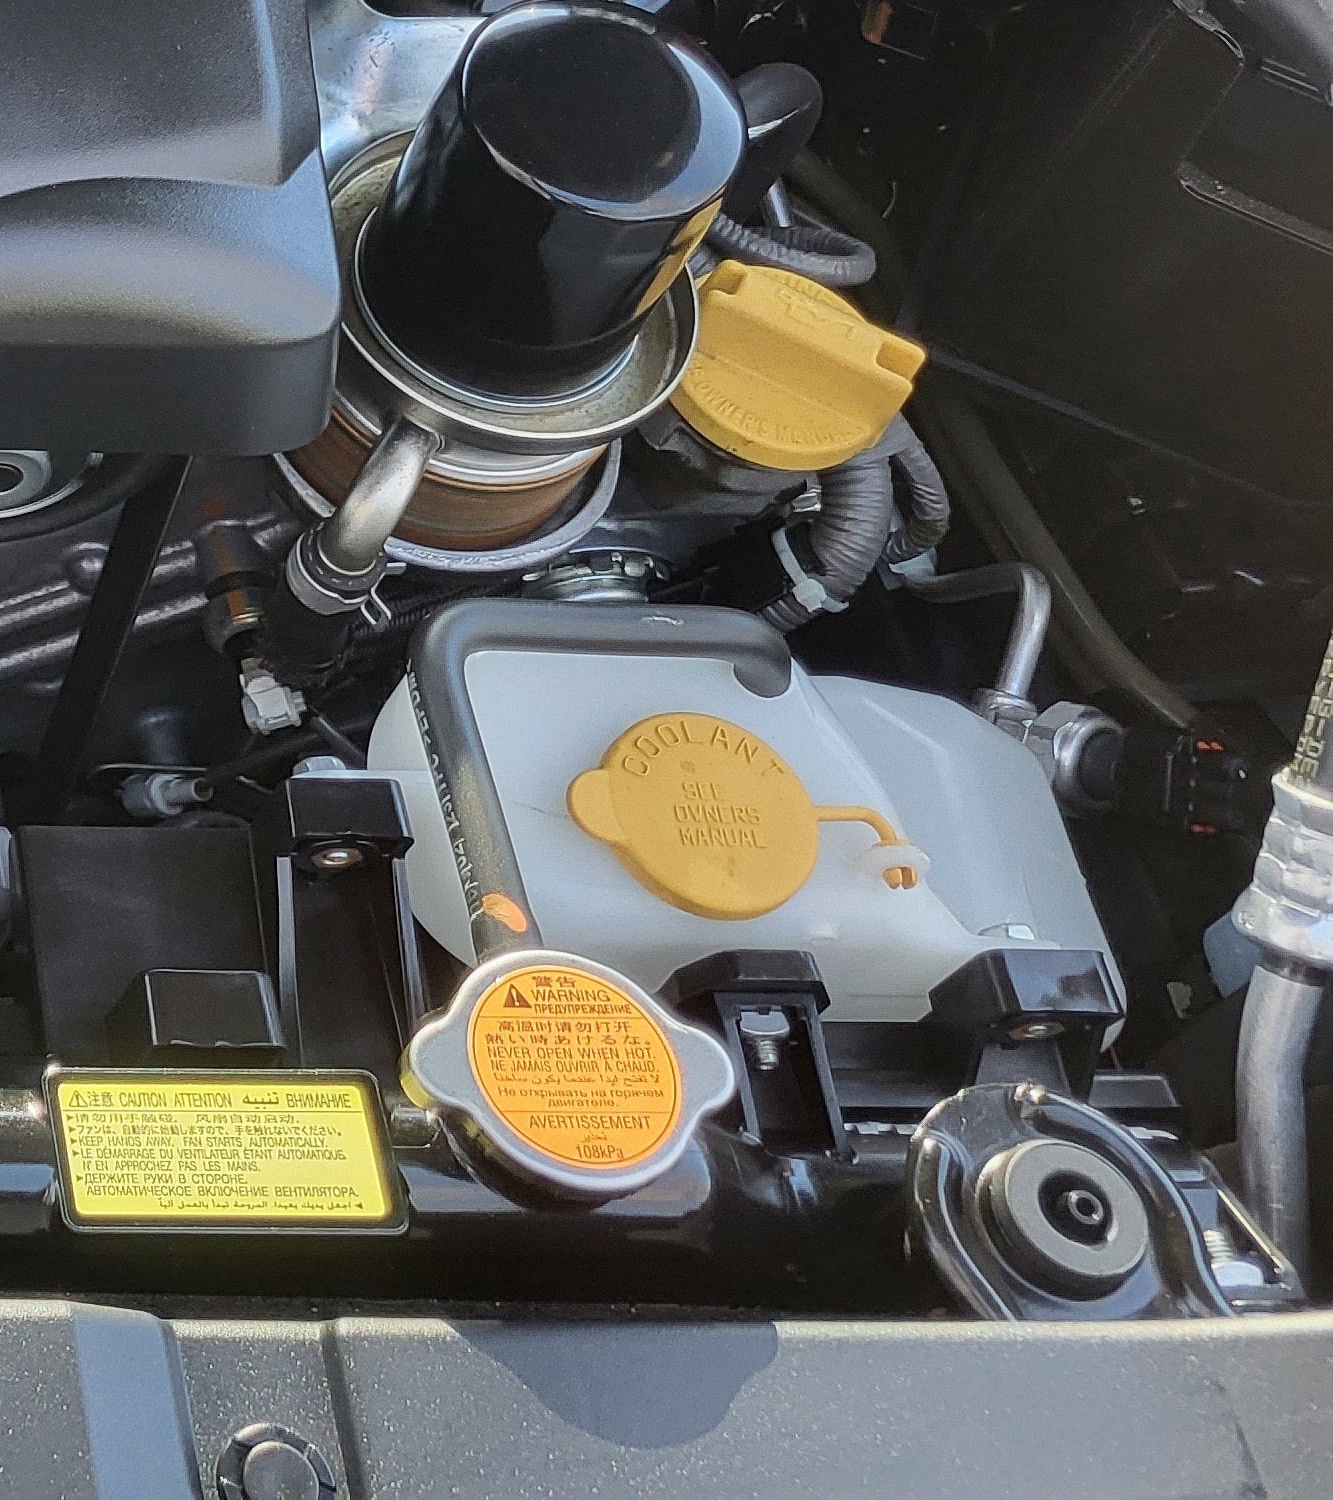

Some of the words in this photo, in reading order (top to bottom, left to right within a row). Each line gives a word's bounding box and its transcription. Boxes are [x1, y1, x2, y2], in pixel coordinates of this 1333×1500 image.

[621, 719, 785, 779] COOLANT
[679, 828, 768, 849] MANUAL
[531, 975, 577, 988] 警告
[531, 989, 611, 1003] WARNING
[534, 1003, 632, 1015] ПРЕДУПРЕЖДЕНИЕ
[487, 1046, 532, 1059] NEVER
[536, 1047, 573, 1059] OPEN
[577, 1047, 620, 1059] WHEN
[626, 1047, 656, 1059] HOT.
[490, 1059, 506, 1071] NE
[510, 1060, 552, 1072] JAMAIS
[555, 1060, 601, 1072] OUVRIR
[615, 1060, 660, 1073] CHAUD.
[87, 1090, 114, 1107] 注意
[119, 1092, 167, 1108] CAUTION
[174, 1092, 232, 1108] ATTENTION
[242, 1091, 280, 1110] تنبيه
[285, 1093, 352, 1109] ВНИМАНИЕ
[529, 1115, 652, 1130] AVERTISSEMENT
[79, 1136, 103, 1147] KEEP
[107, 1136, 142, 1147] HANDS
[146, 1136, 175, 1148] AWAY.
[183, 1136, 202, 1147] FAN
[206, 1136, 243, 1148] STARTS
[249, 1137, 328, 1148] AUTOMATICALLY.
[81, 1148, 93, 1159] LE
[96, 1146, 156, 1159] DÉMARRAGE
[159, 1148, 173, 1159] DU
[176, 1148, 239, 1160] VENTILATEUR
[243, 1147, 273, 1160] ÉTANT
[575, 1145, 625, 1160] 108kPa
[115, 1160, 173, 1171] APPROCHEZ
[178, 1160, 198, 1172] PAS
[203, 1161, 221, 1172] LES
[227, 1161, 261, 1172] MAINS.
[84, 1173, 138, 1186] ДЕРЖИТЕ
[144, 1173, 174, 1184] РУКИ
[178, 1173, 187, 1184] В
[191, 1173, 248, 1184] СТОРОНЕ.
[86, 1185, 192, 1197] АВТОМАТИЧЕСКОЕ
[198, 1186, 269, 1197] ВКЛЮЧЕНИЕ
[275, 1186, 360, 1198] ВЕНТИЛЯТОРА.
